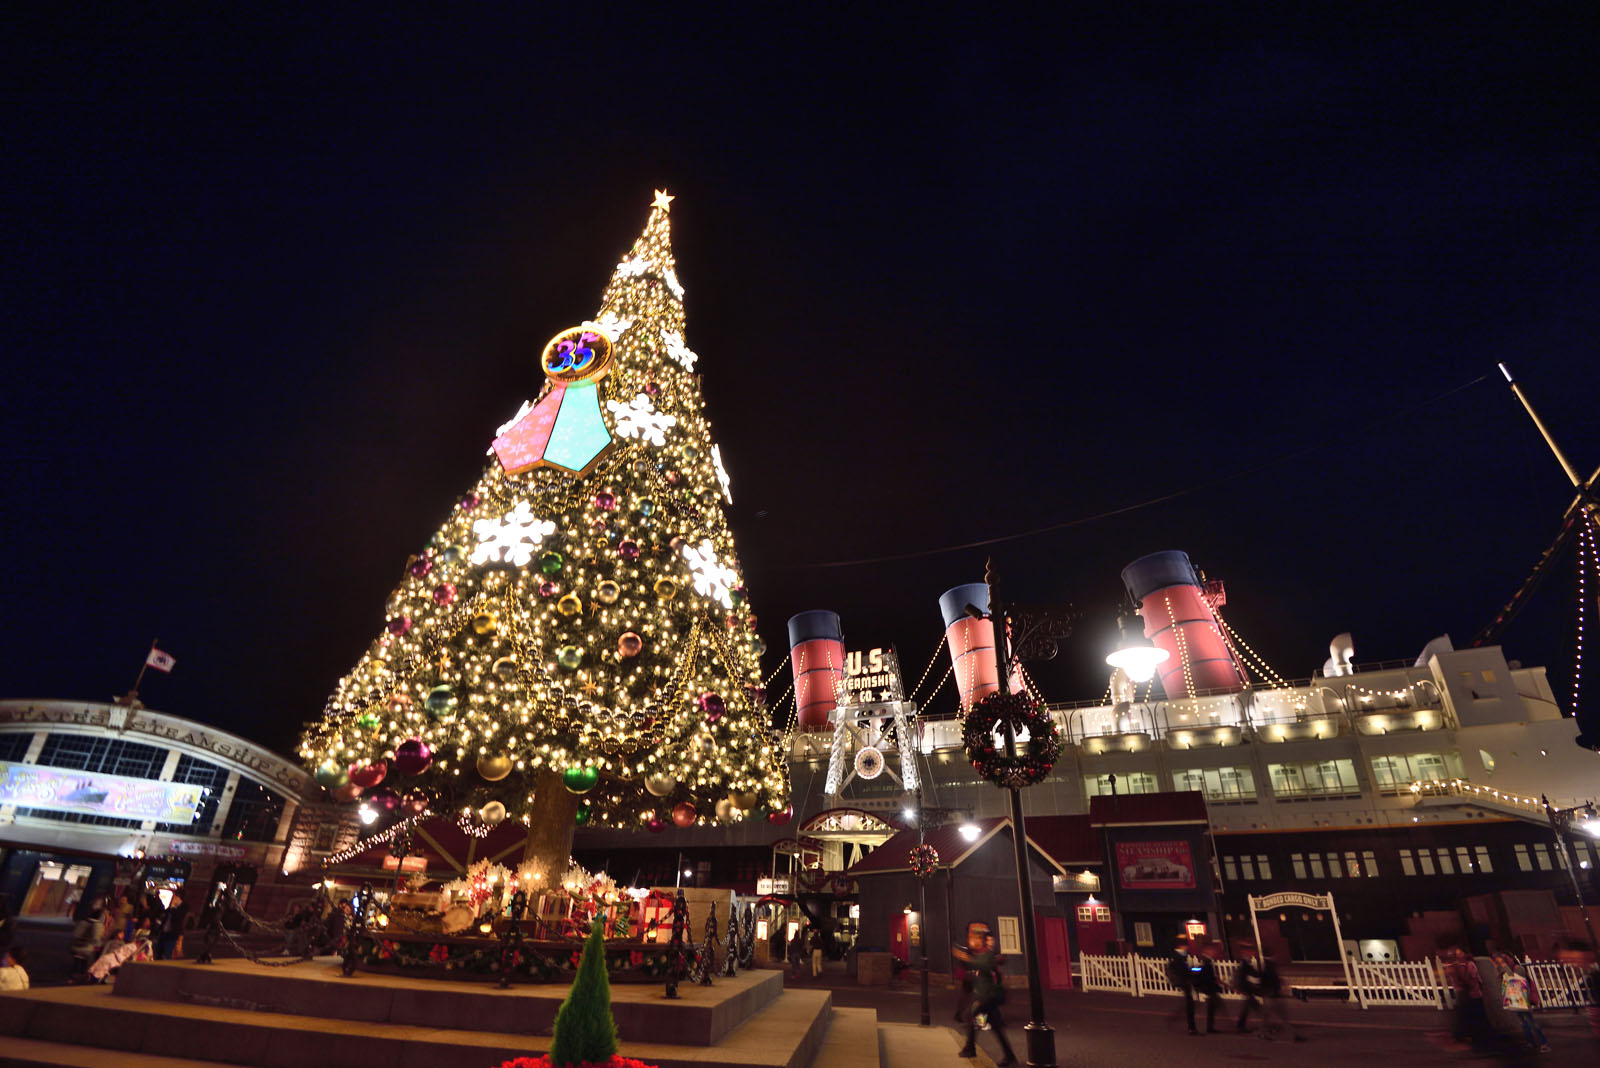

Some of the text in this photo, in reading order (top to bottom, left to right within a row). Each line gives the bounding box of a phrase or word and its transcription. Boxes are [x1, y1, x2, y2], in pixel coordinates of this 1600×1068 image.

[547, 332, 601, 373] 35
[847, 648, 890, 676] U.S.
[837, 673, 896, 690] STEAMSHIP
[859, 690, 876, 703] CO.
[132, 720, 271, 771] STEAMSHIP
[1284, 894, 1303, 904] CARGO
[1303, 895, 1319, 907] ONLY
